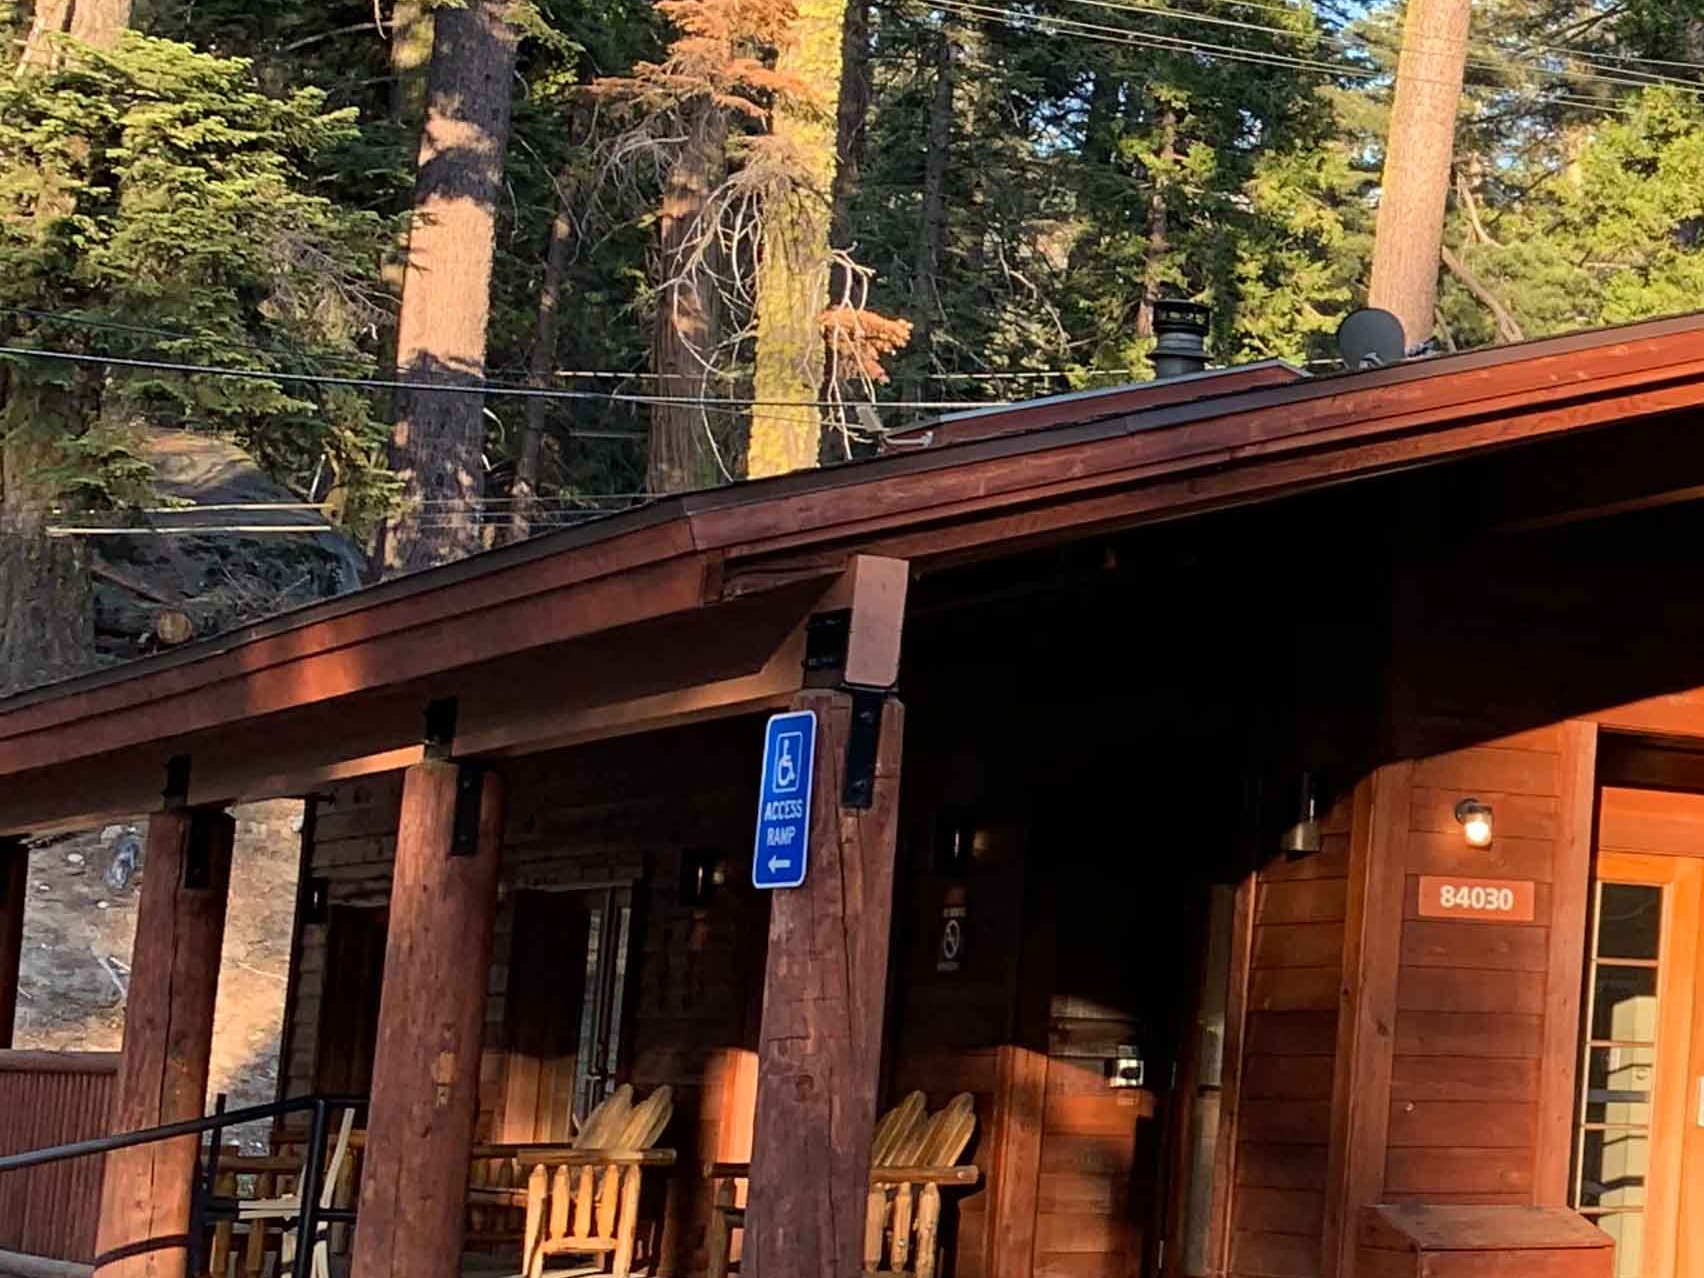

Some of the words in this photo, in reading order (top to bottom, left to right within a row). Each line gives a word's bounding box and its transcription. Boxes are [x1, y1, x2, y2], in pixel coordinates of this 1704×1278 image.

[764, 800, 803, 821] ACCESS
[766, 825, 796, 846] RAMP
[1439, 884, 1514, 911] 84030
